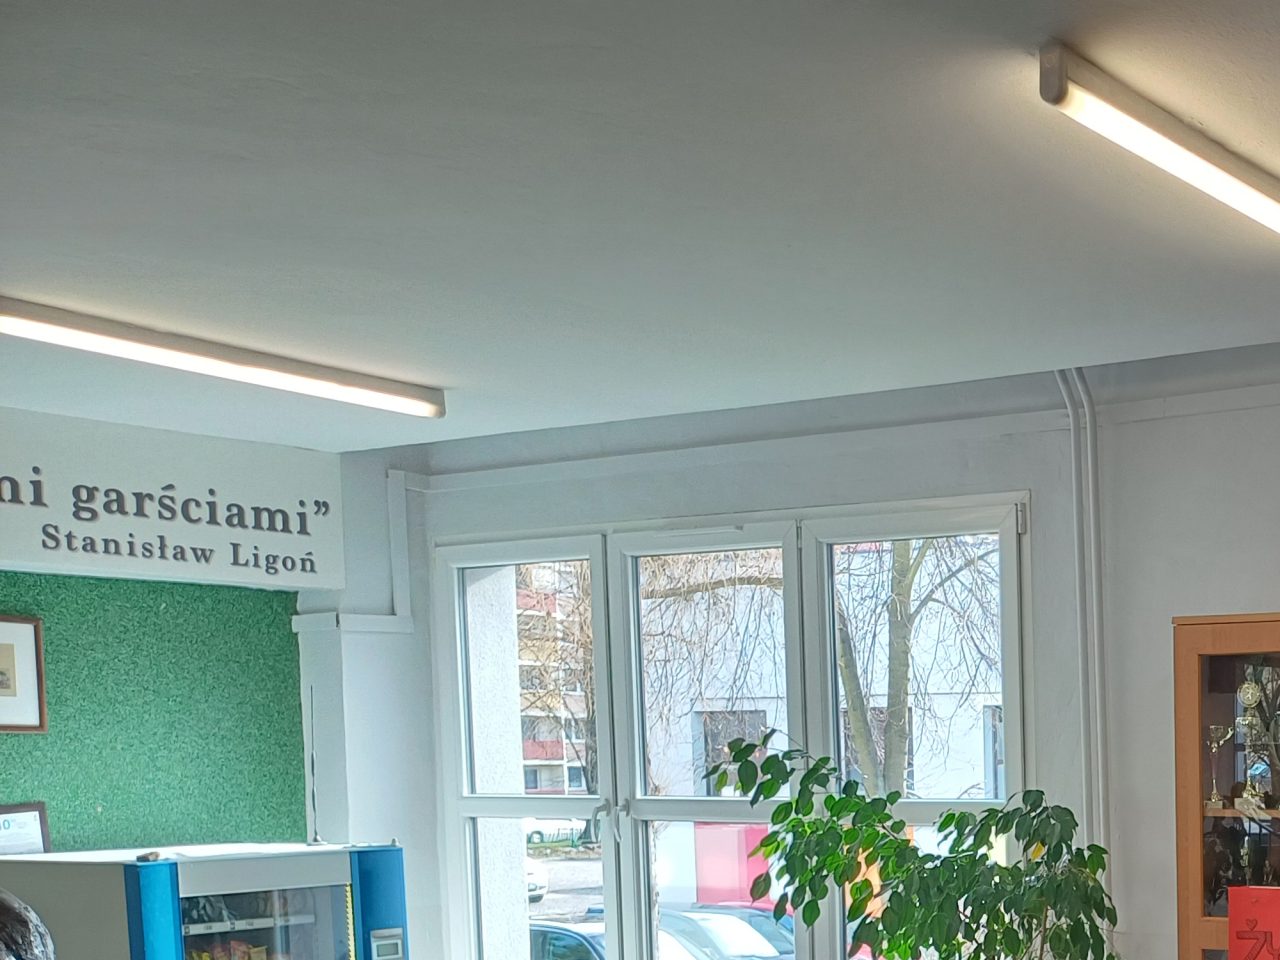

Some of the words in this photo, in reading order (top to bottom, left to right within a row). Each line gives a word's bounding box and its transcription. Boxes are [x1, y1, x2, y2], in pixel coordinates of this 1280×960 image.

[72, 484, 330, 536] garściami”
[41, 523, 215, 565] Stanisław
[229, 542, 317, 575] Ligoń
